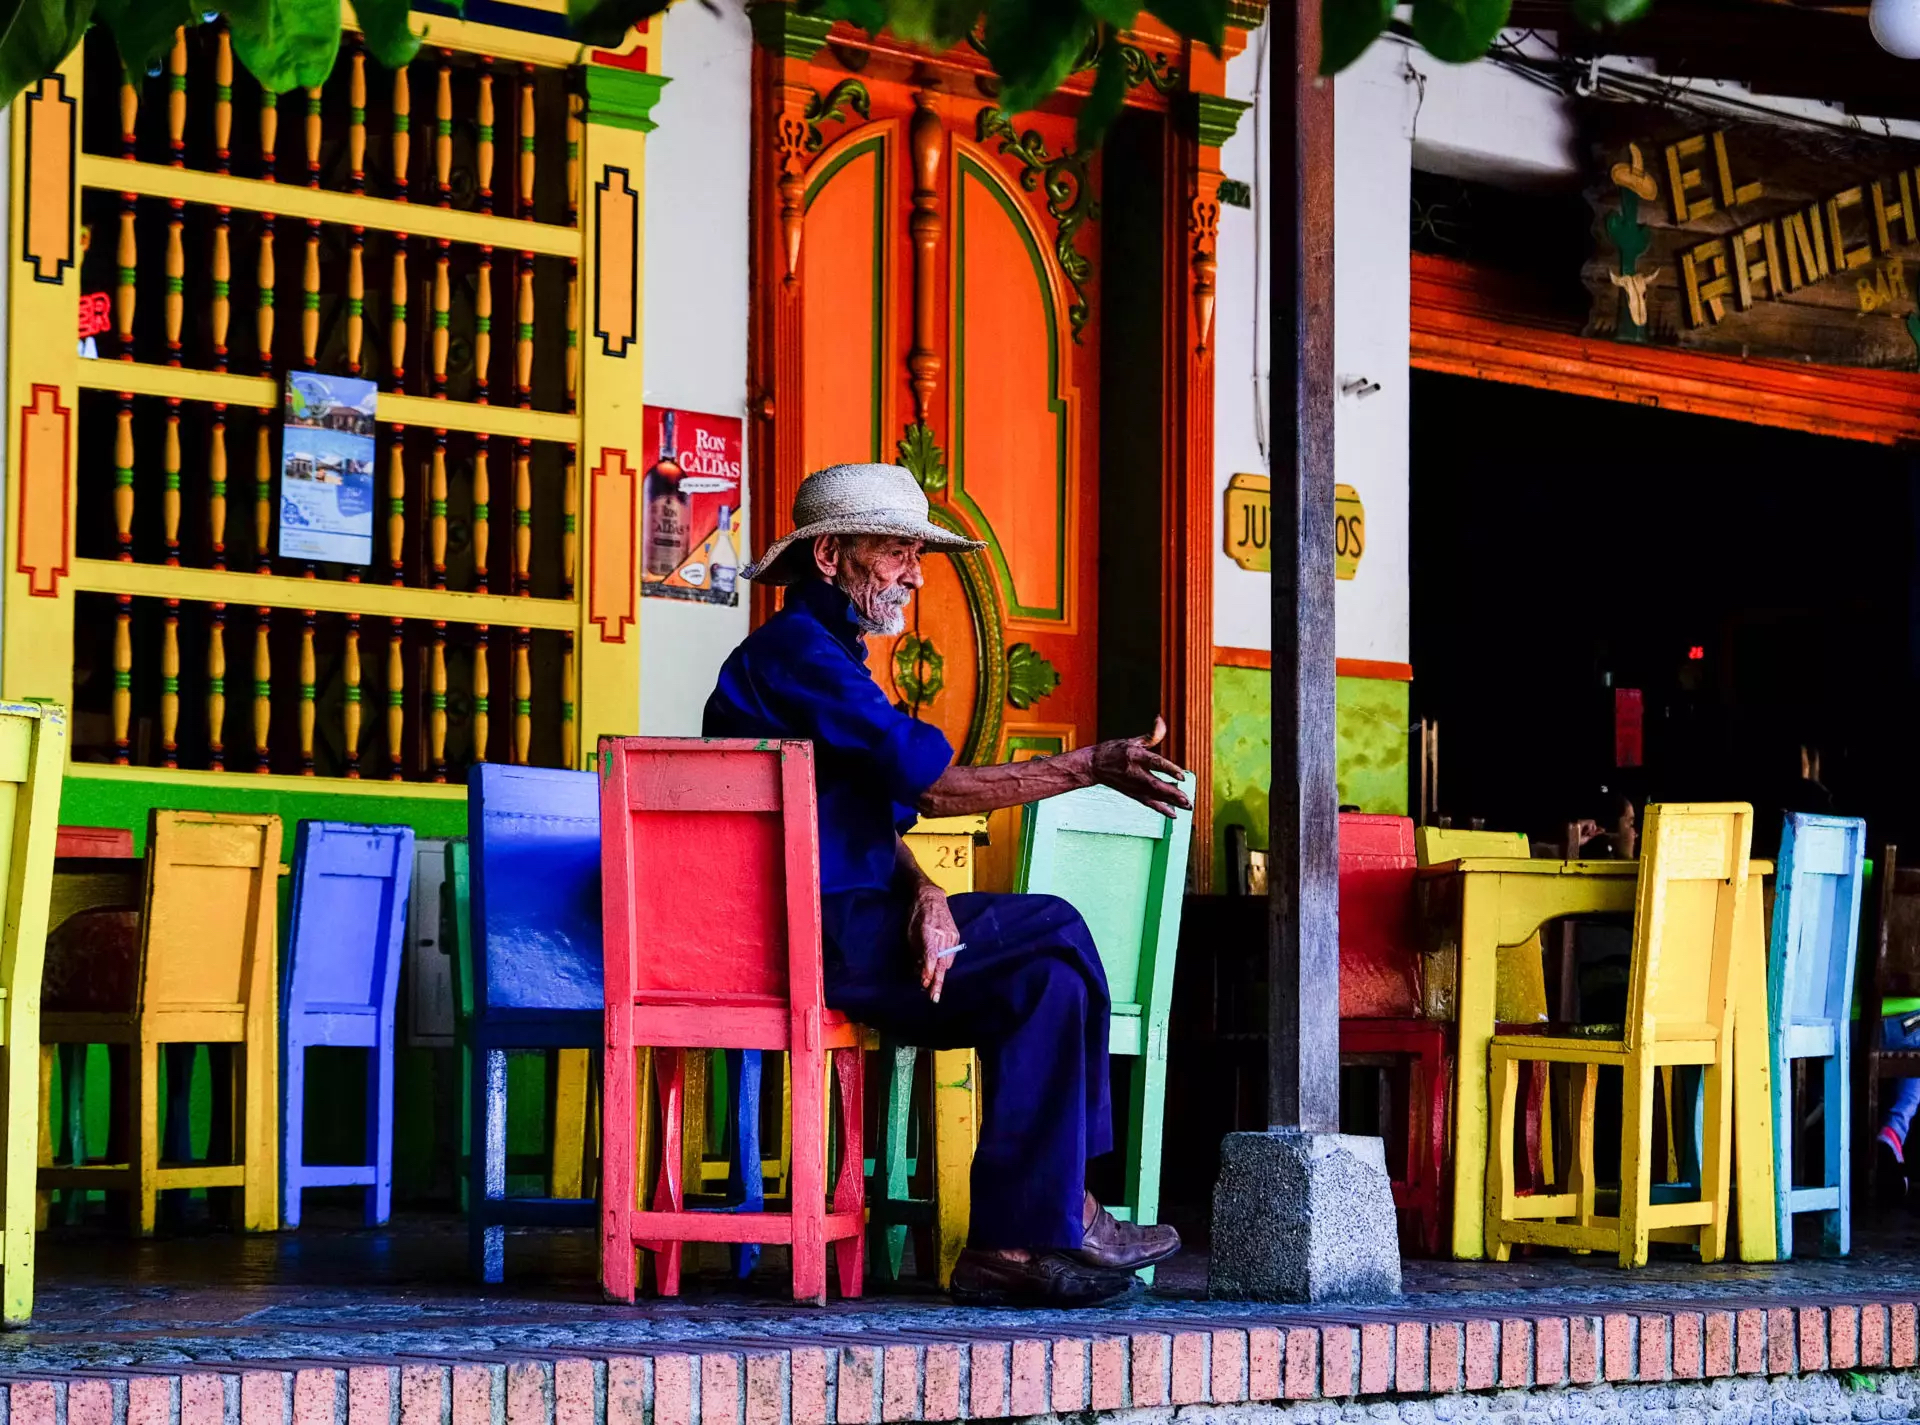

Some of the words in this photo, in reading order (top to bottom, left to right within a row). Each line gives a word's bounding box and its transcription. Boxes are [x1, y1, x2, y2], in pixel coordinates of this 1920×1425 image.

[1665, 130, 1764, 225] EL
[1681, 165, 1920, 330] RANCH
[1856, 257, 1908, 313] BAR
[679, 451, 740, 478] CALDAS
[934, 845, 969, 869] 28
